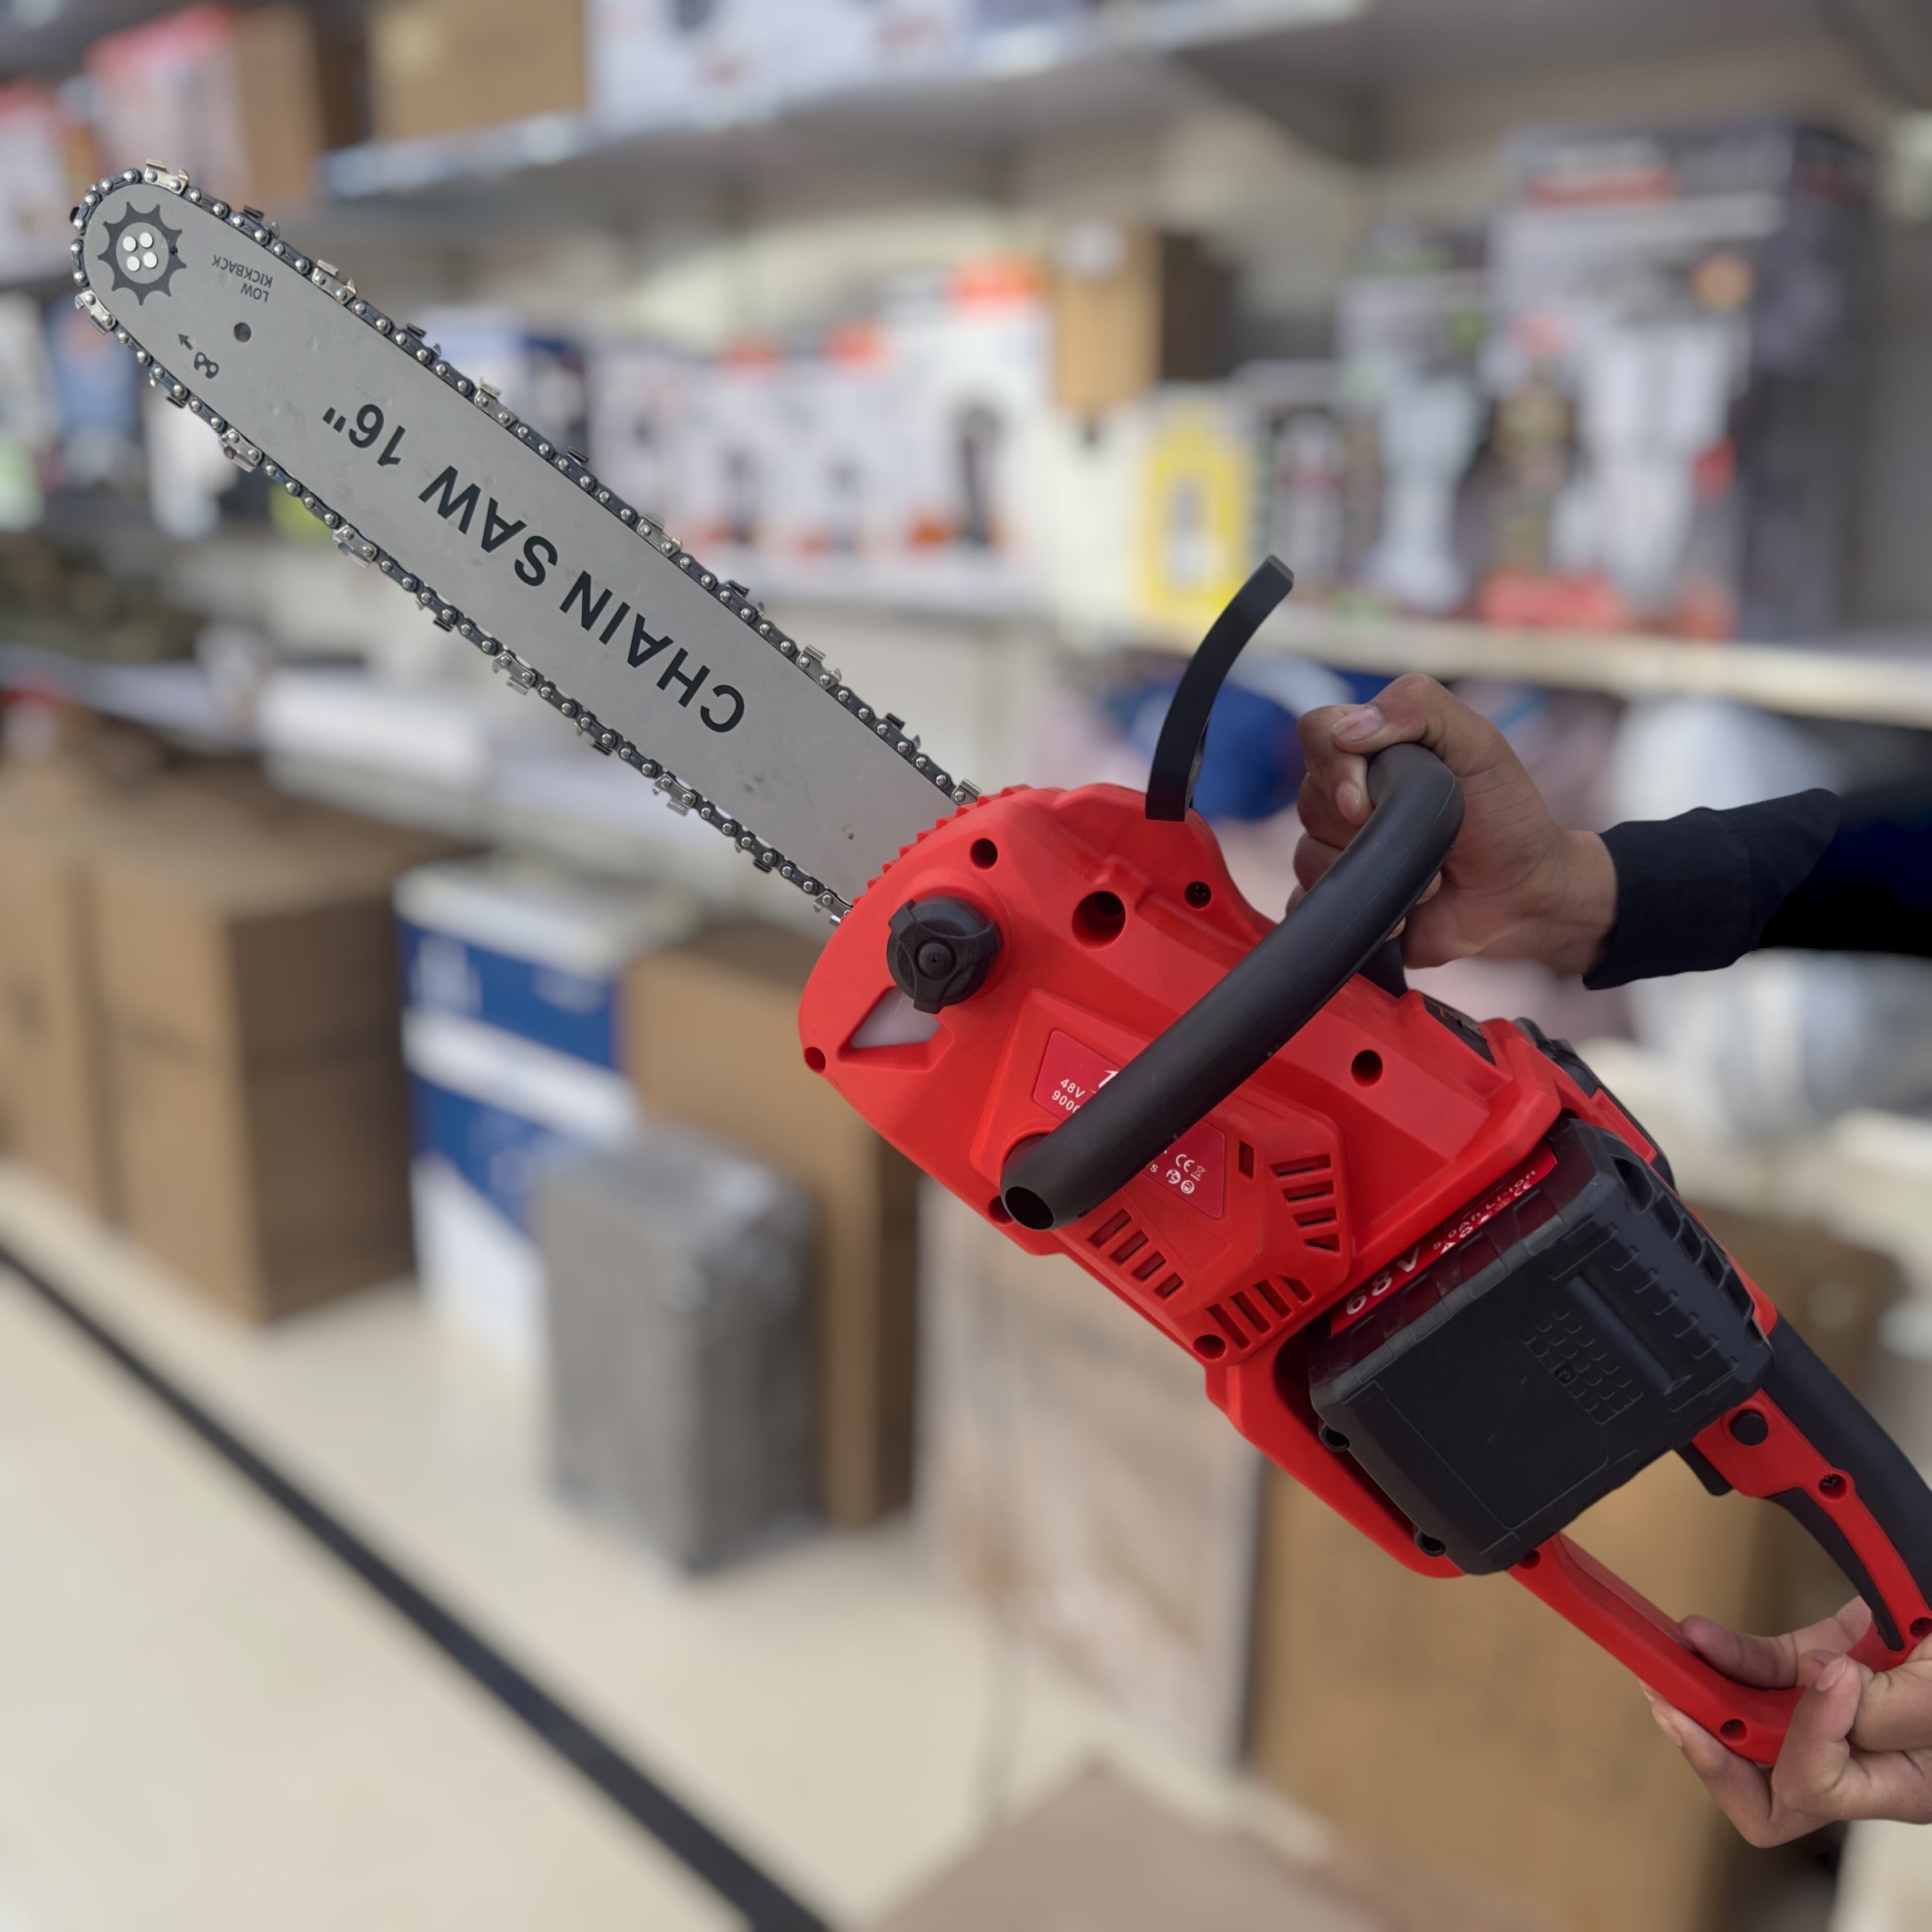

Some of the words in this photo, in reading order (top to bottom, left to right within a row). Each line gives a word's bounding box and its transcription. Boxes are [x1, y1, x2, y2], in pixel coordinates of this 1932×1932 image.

[212, 254, 274, 288] KICKBACK
[240, 283, 270, 303] LOW
[322, 403, 407, 468] 16"
[418, 464, 559, 587] SAW
[559, 570, 745, 733] CHAIN
[1059, 1079, 1086, 1099] 48V
[1345, 1245, 1420, 1315] 68V
